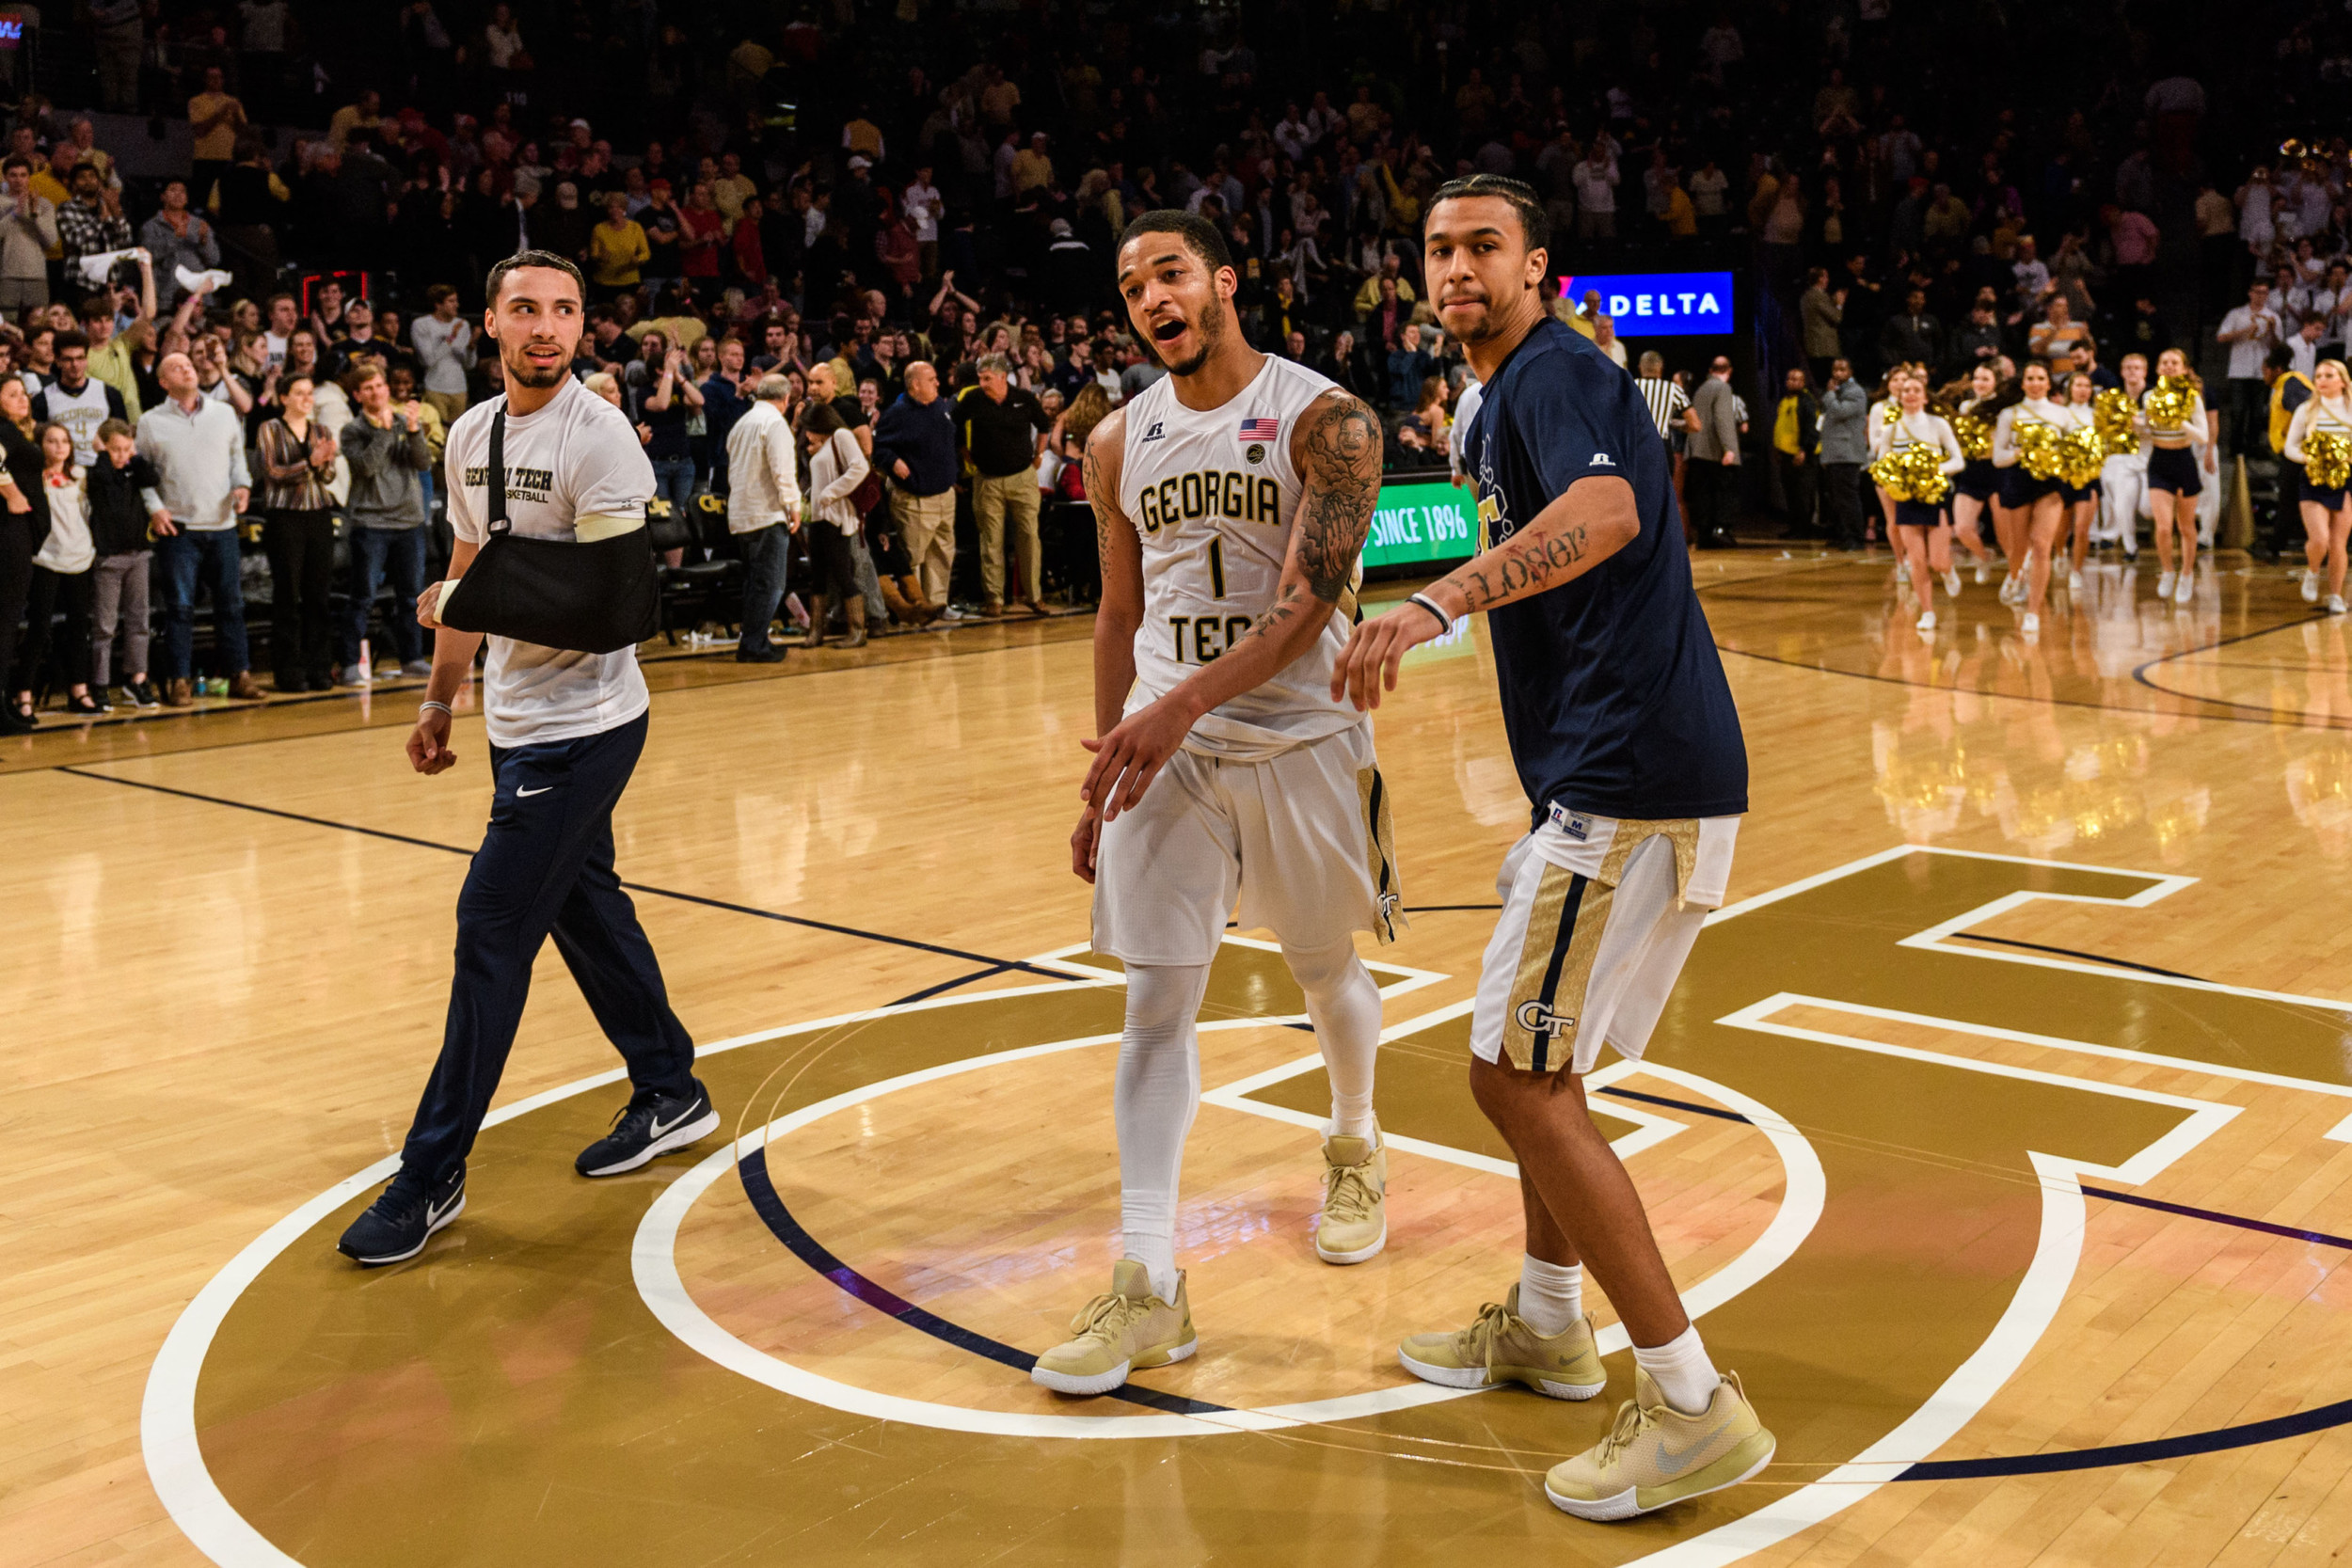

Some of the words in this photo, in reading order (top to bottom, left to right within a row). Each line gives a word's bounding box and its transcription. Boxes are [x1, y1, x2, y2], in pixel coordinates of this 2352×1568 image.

[1610, 293, 1720, 317] DELTA
[75, 420, 87, 438] 4
[516, 467, 553, 492] TECH
[505, 489, 548, 504] SKETBALL
[1139, 469, 1281, 533] GEORGIA
[1371, 507, 1422, 547] SINCE
[1422, 504, 1469, 542] 1896
[1208, 531, 1227, 603] 1
[1168, 616, 1263, 665] TEC
[1571, 819, 1582, 831] M
[1516, 1000, 1575, 1039] GT
